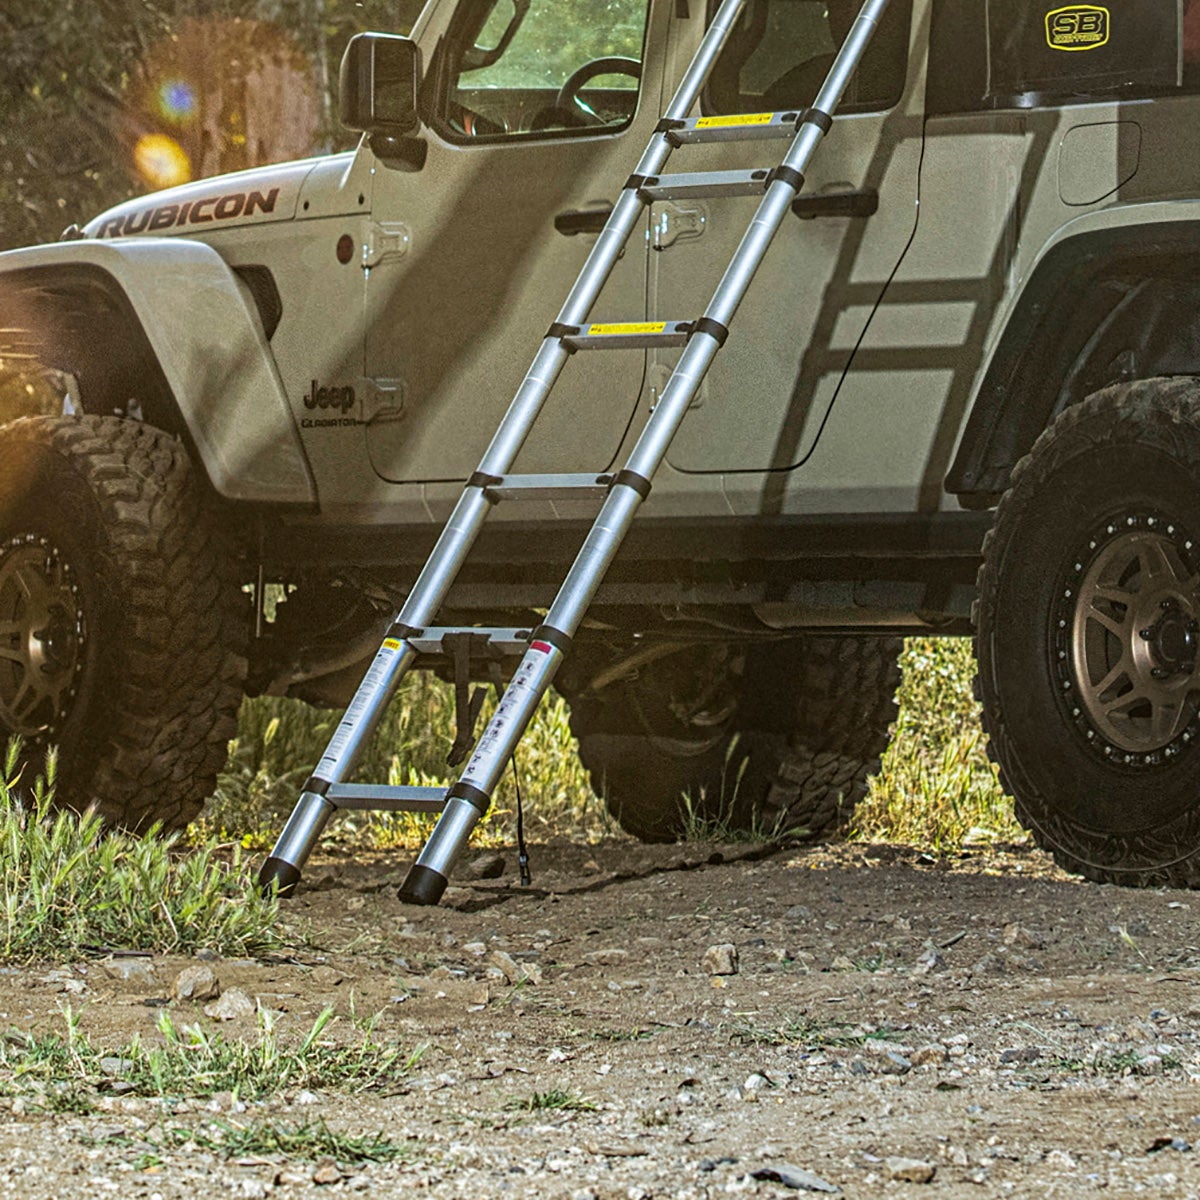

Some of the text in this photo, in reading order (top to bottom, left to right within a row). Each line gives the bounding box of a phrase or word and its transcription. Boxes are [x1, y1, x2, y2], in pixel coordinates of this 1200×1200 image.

[1052, 11, 1104, 36] SB
[97, 188, 280, 238] RUBICON
[303, 380, 355, 414] Jeep
